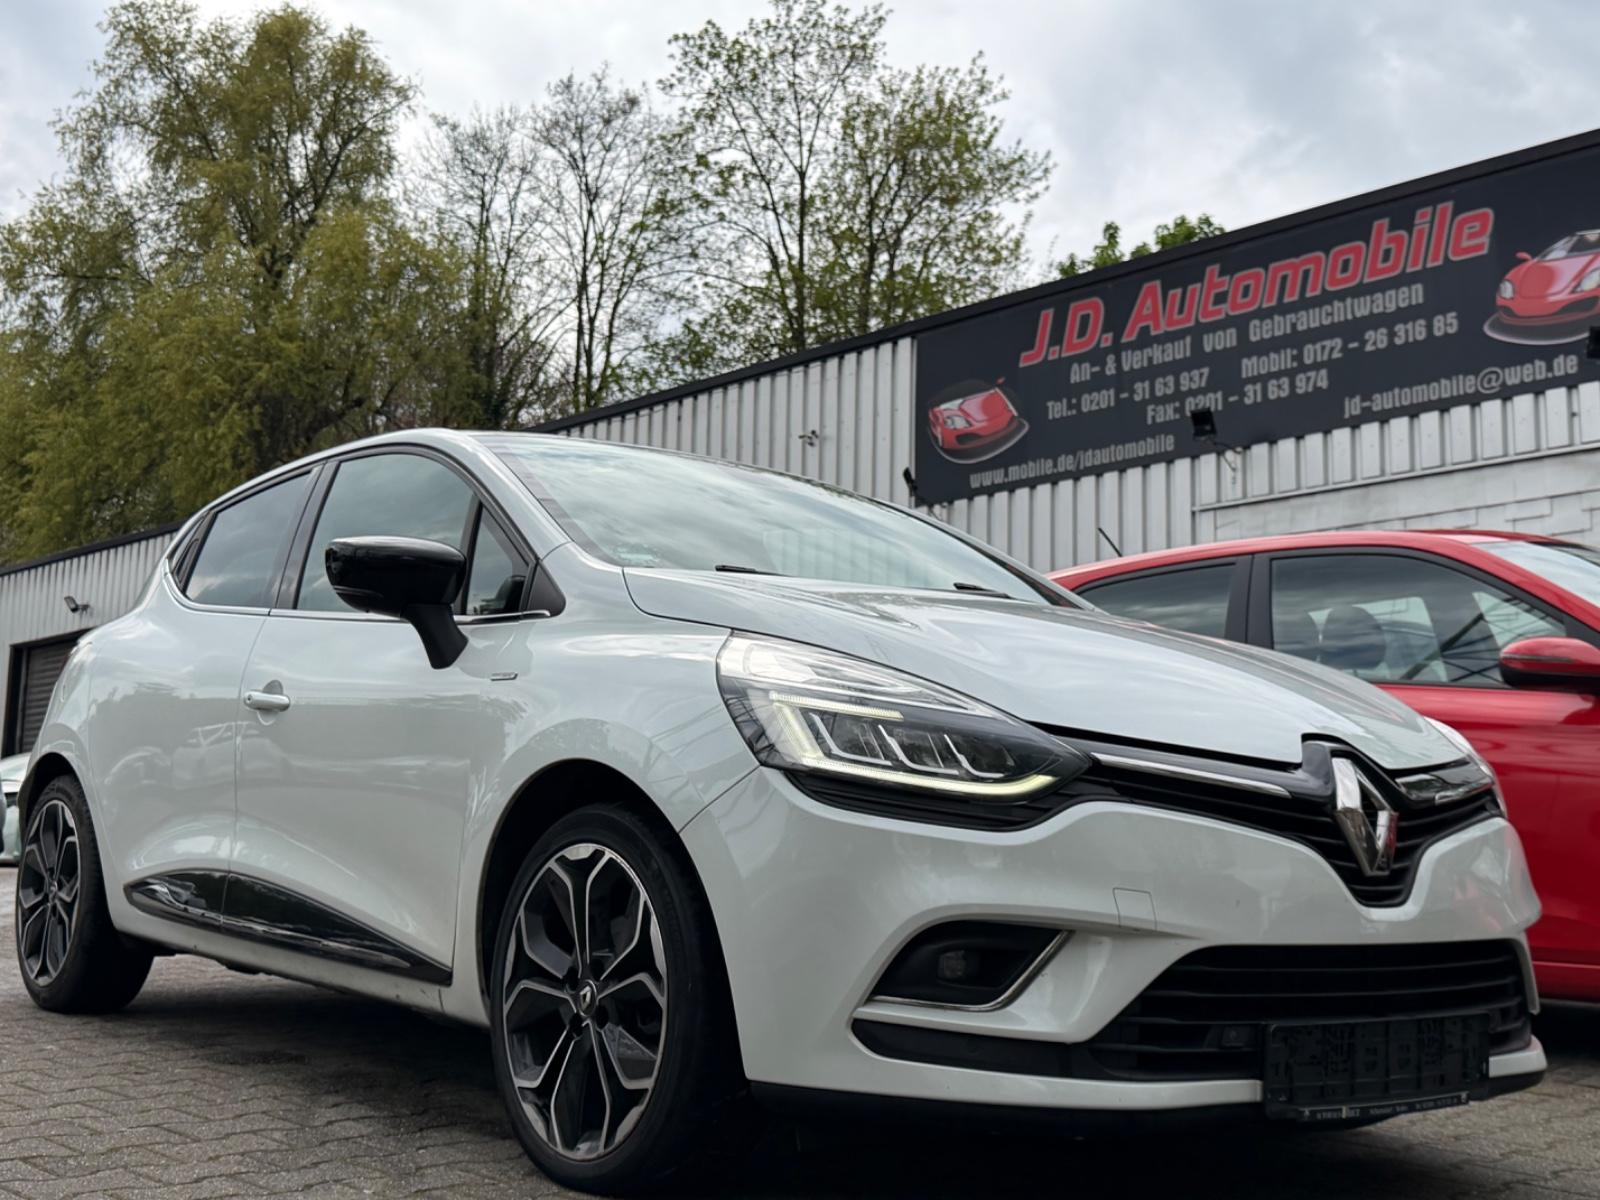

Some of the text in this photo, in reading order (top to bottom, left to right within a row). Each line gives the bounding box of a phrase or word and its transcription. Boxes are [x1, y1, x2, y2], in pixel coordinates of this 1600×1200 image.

[1019, 201, 1494, 367] J.D. Automobile
[1070, 283, 1424, 383] An- & Verkauf von Gebrauchtwagen
[1241, 348, 1298, 378] Mobil:
[1303, 338, 1343, 364] 0172
[1364, 328, 1388, 352] 26
[1394, 319, 1427, 345] 316
[1432, 312, 1459, 336] 85
[1046, 398, 1077, 420] Tel.:
[1081, 388, 1115, 412] 0201
[1133, 380, 1150, 402] 31
[1155, 375, 1174, 397] 63
[1179, 367, 1210, 391] 937
[1146, 401, 1180, 425] Fax:
[1243, 382, 1262, 405] 31
[1267, 377, 1290, 400] 63
[1295, 369, 1329, 394] 974
[1344, 354, 1578, 418] jd-automobile@web.de
[969, 434, 1175, 489] www.mobile.de/jdautomobile
